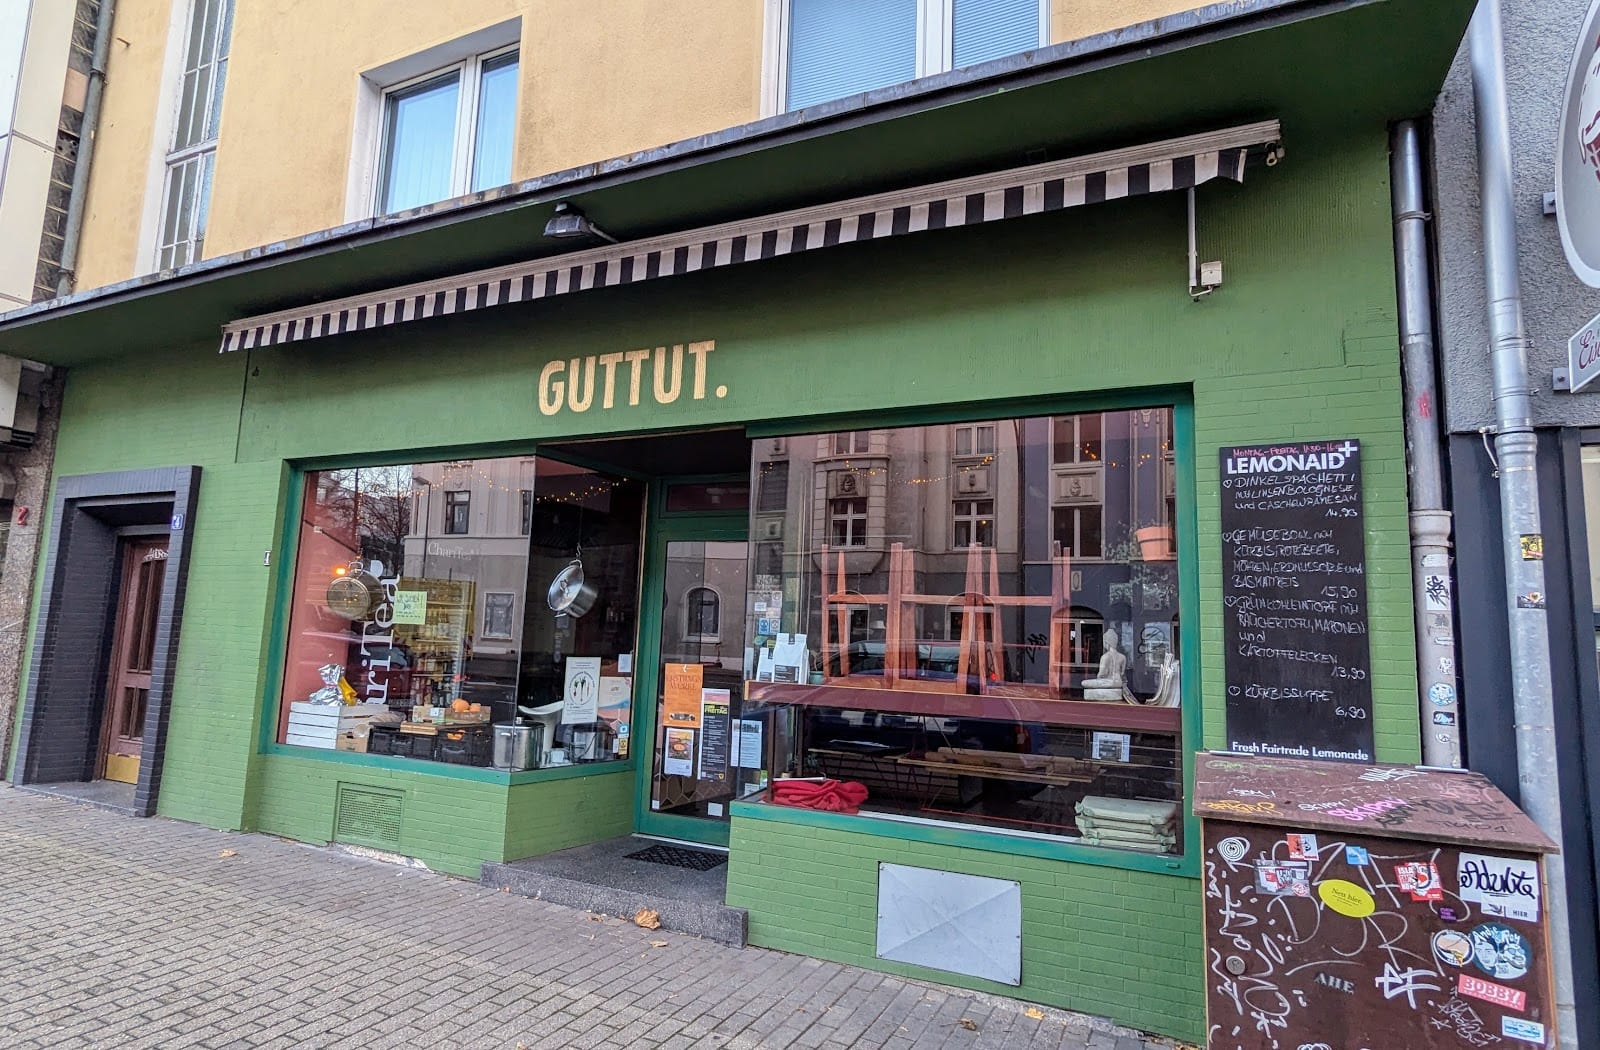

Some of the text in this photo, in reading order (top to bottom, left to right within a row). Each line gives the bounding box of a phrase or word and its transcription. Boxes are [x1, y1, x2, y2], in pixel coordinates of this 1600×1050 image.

[538, 340, 728, 416] GUTTUT.
[1239, 631, 1266, 643] und
[1232, 741, 1369, 761] Fresh Fairtrade Lemonade
[1463, 977, 1522, 1004] BOBBY
